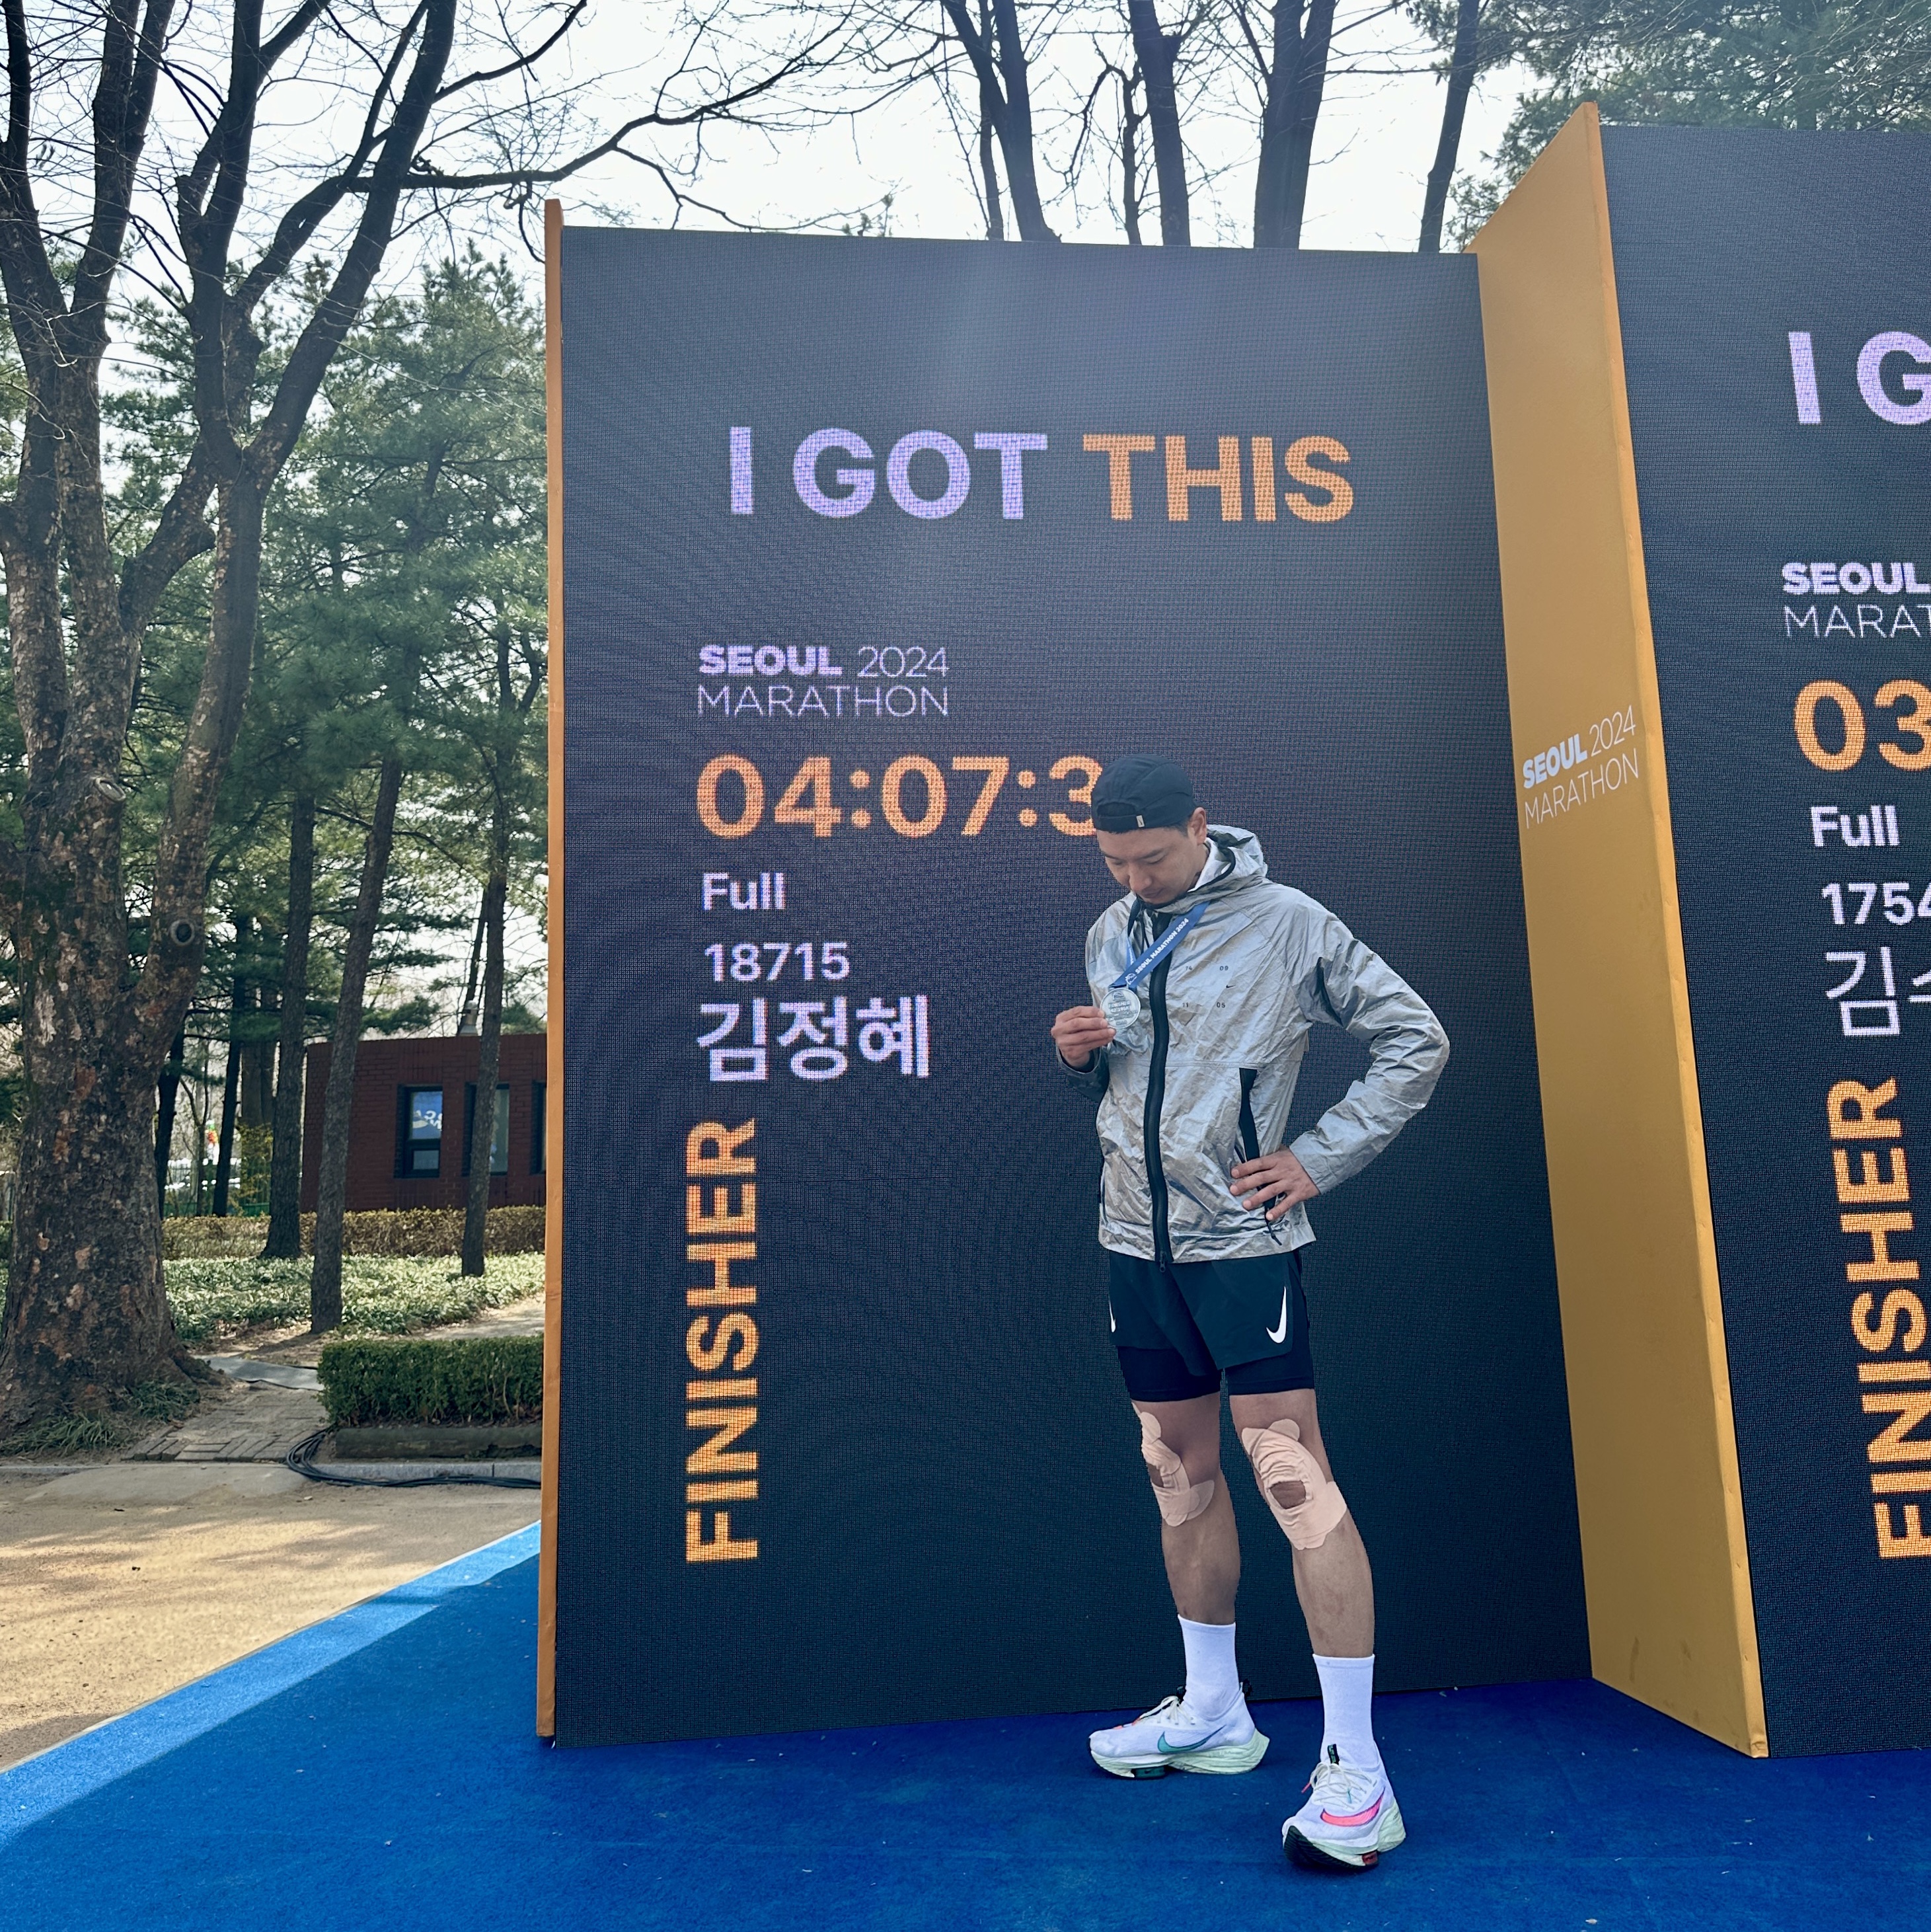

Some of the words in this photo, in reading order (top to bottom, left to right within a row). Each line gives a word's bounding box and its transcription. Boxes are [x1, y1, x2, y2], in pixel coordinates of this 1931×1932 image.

[1788, 331, 1821, 424] I
[729, 426, 753, 515] I
[793, 428, 1048, 520] GOT
[1083, 434, 1353, 522] THIS
[1782, 562, 1931, 595] SEOUL
[699, 644, 843, 677] SEOUL
[857, 645, 949, 678] 2024
[697, 685, 949, 718] MARATHON
[1523, 734, 1587, 789] SEOUL
[1589, 705, 1636, 757] 2024
[697, 753, 1103, 838] 04:07:3
[1525, 748, 1639, 829] MARATHON
[1811, 805, 1900, 847] Full
[702, 872, 786, 911] Full
[704, 941, 851, 982] 18715
[1135, 958, 1153, 974] SEOUL
[1150, 931, 1178, 959] MARATHON
[1176, 917, 1189, 933] 2024
[697, 995, 929, 1081] 김정혜
[685, 1118, 759, 1562] FINISHER
